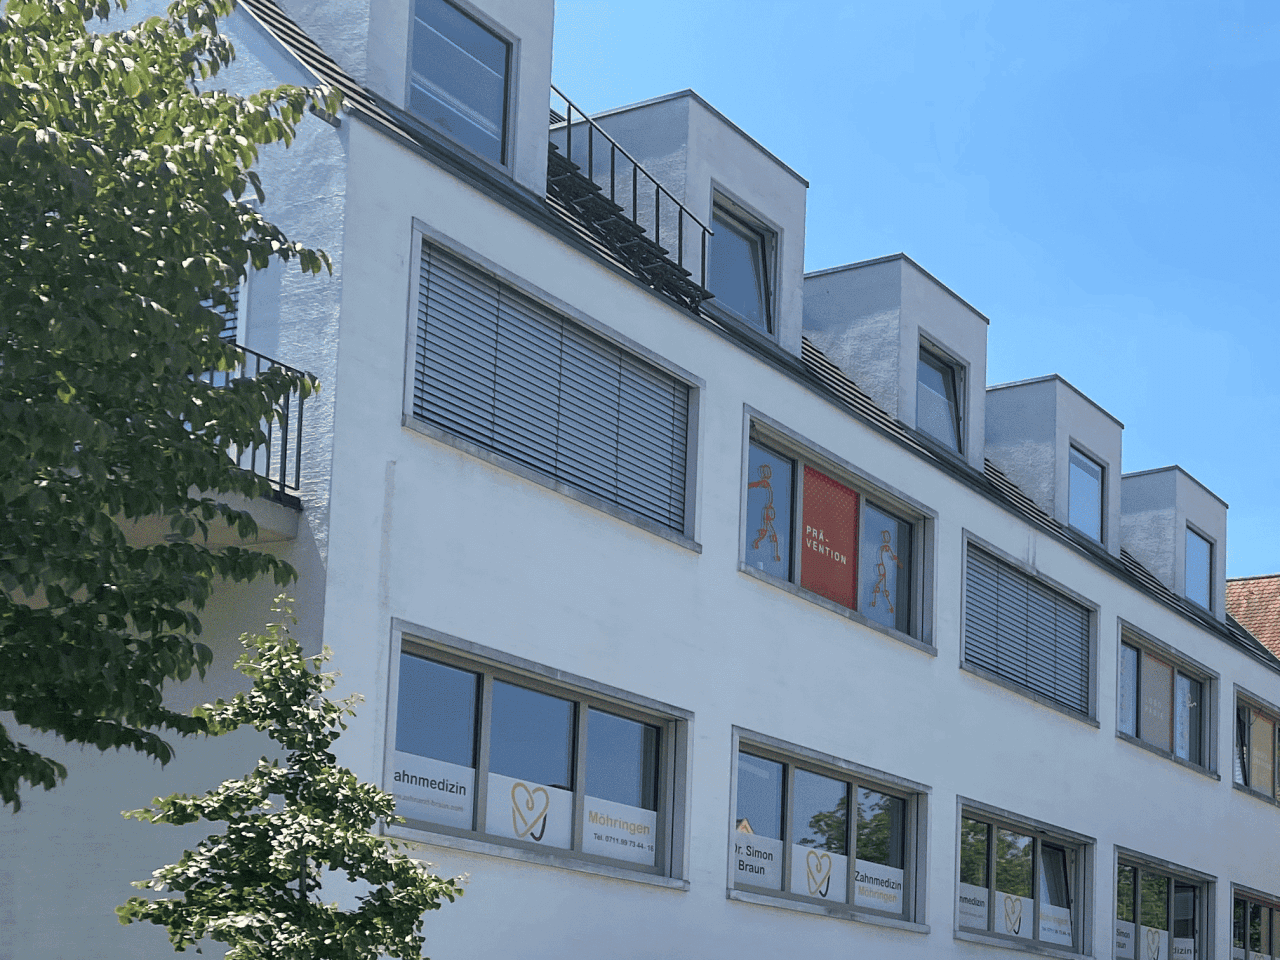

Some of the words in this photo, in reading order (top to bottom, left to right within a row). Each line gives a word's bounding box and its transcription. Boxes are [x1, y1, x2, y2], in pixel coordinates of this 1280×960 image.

[806, 524, 829, 542] PRÄ-
[806, 538, 847, 565] VENTION
[588, 810, 651, 835] Möhringen
[745, 845, 774, 862] Simon
[738, 859, 766, 876] Braun
[854, 870, 902, 891] Zahnmedizin
